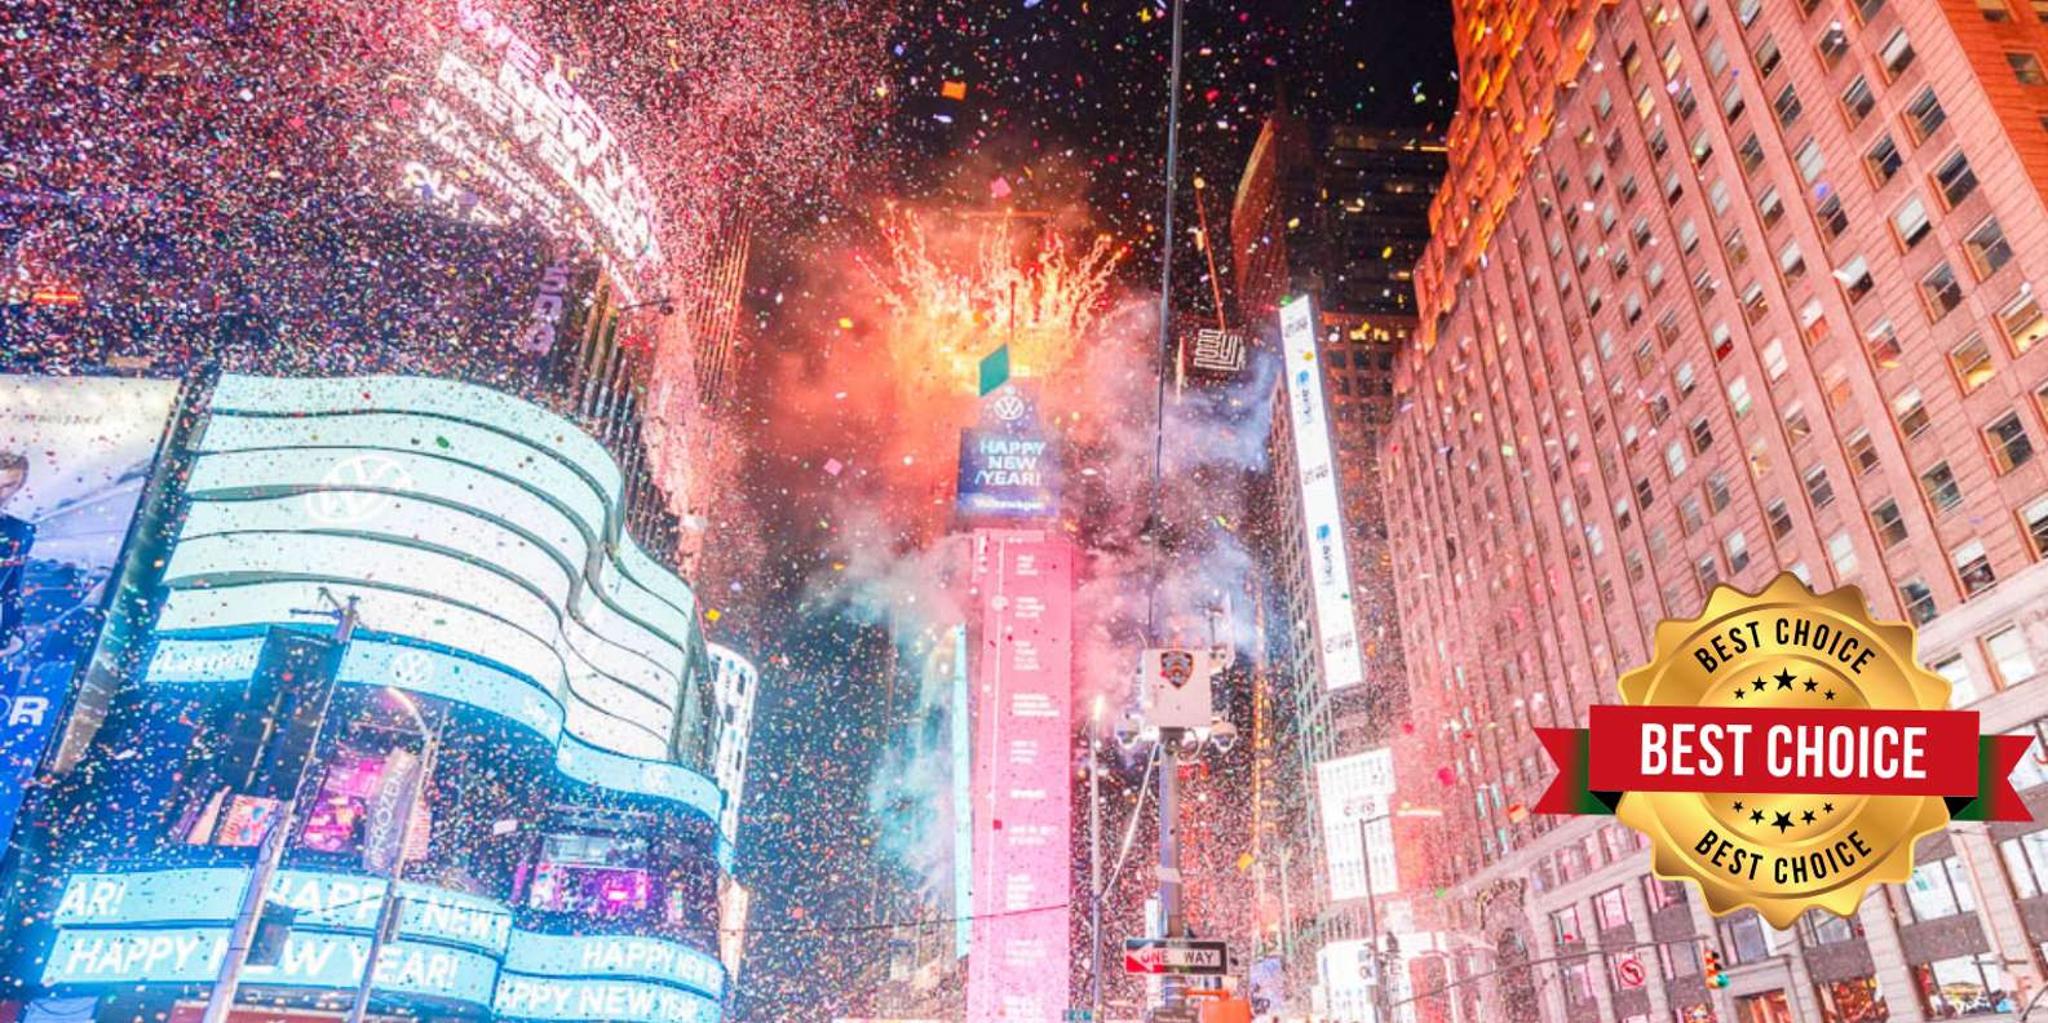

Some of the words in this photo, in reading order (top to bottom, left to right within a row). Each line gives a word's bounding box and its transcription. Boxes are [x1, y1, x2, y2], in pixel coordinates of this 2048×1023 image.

[980, 440, 1046, 455] HAPPY
[988, 455, 1037, 470] NEW
[64, 936, 200, 976] HAPPY
[582, 940, 674, 973] HAPPY
[1184, 951, 1214, 963] WAY
[578, 985, 656, 1018] NEW
